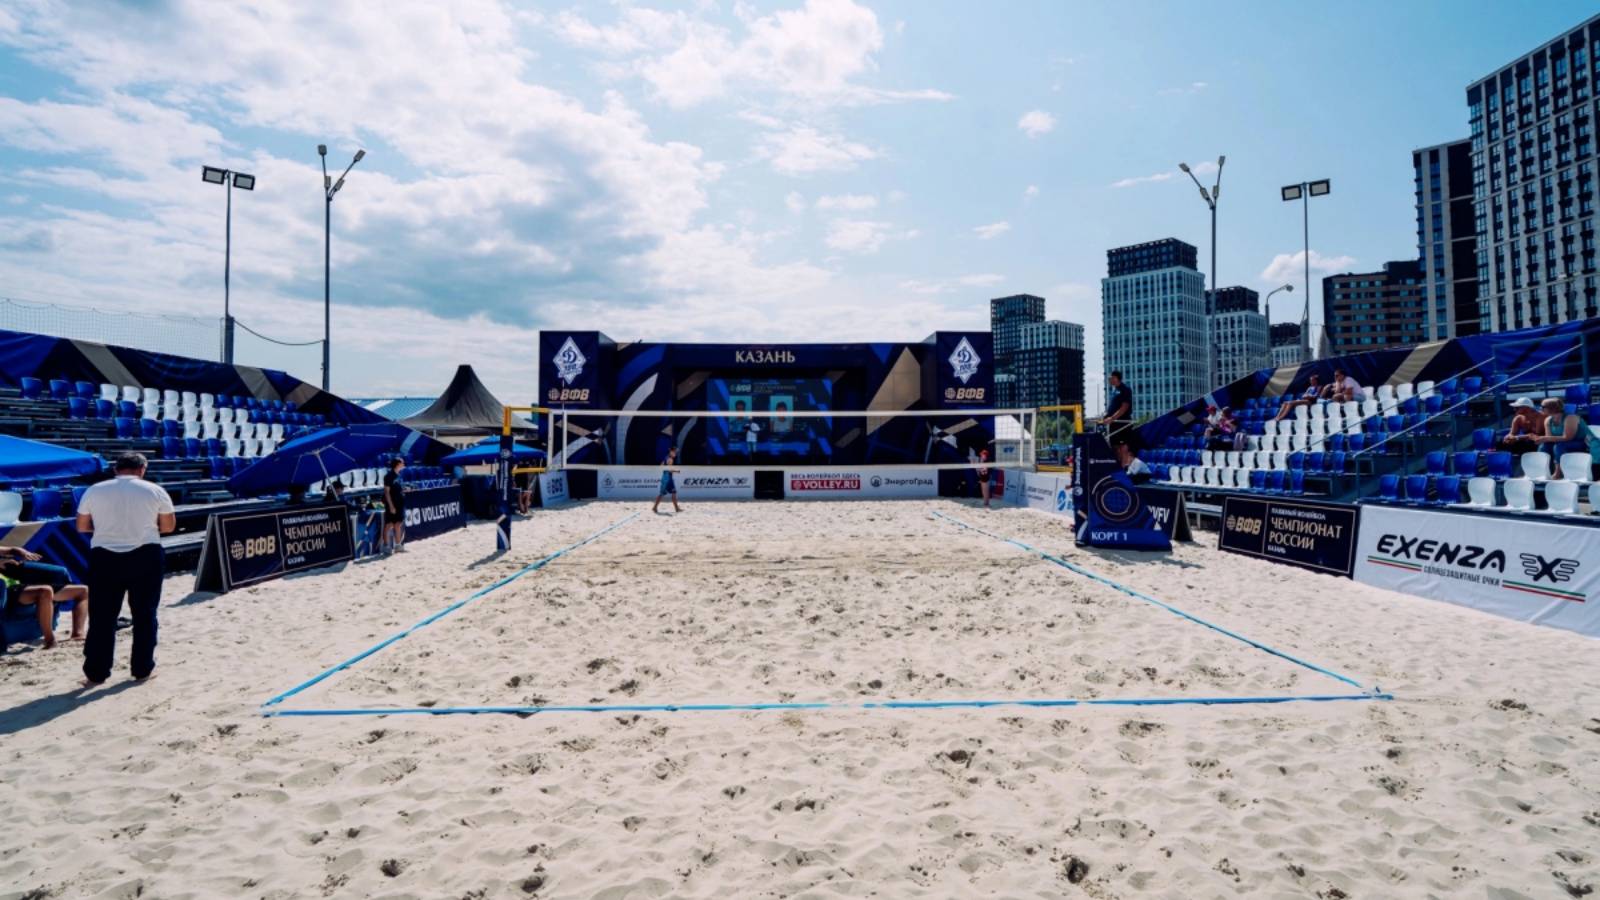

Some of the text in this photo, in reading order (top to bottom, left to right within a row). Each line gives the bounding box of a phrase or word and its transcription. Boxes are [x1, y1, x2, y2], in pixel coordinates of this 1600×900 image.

[735, 350, 796, 363] КАЗАНЬ
[560, 388, 590, 401] ВФВ
[956, 388, 985, 400] ВФВ
[683, 477, 730, 486] EXENZA
[802, 480, 858, 489] VOLLEY.RU
[884, 477, 933, 486] ЭнергоГрад
[421, 501, 460, 522] VOLLEYVFV
[284, 520, 341, 540] ЧЕМПИОНАТ
[1235, 516, 1262, 535] ВФВ
[1271, 517, 1343, 539] ЧЕМПИОНАТ
[1091, 531, 1128, 541] КОРТ 1
[1269, 531, 1314, 550] РОССИИ
[245, 535, 276, 559] ВФВ
[286, 537, 326, 556] РОССИИ
[1376, 534, 1506, 573] EXENZA
